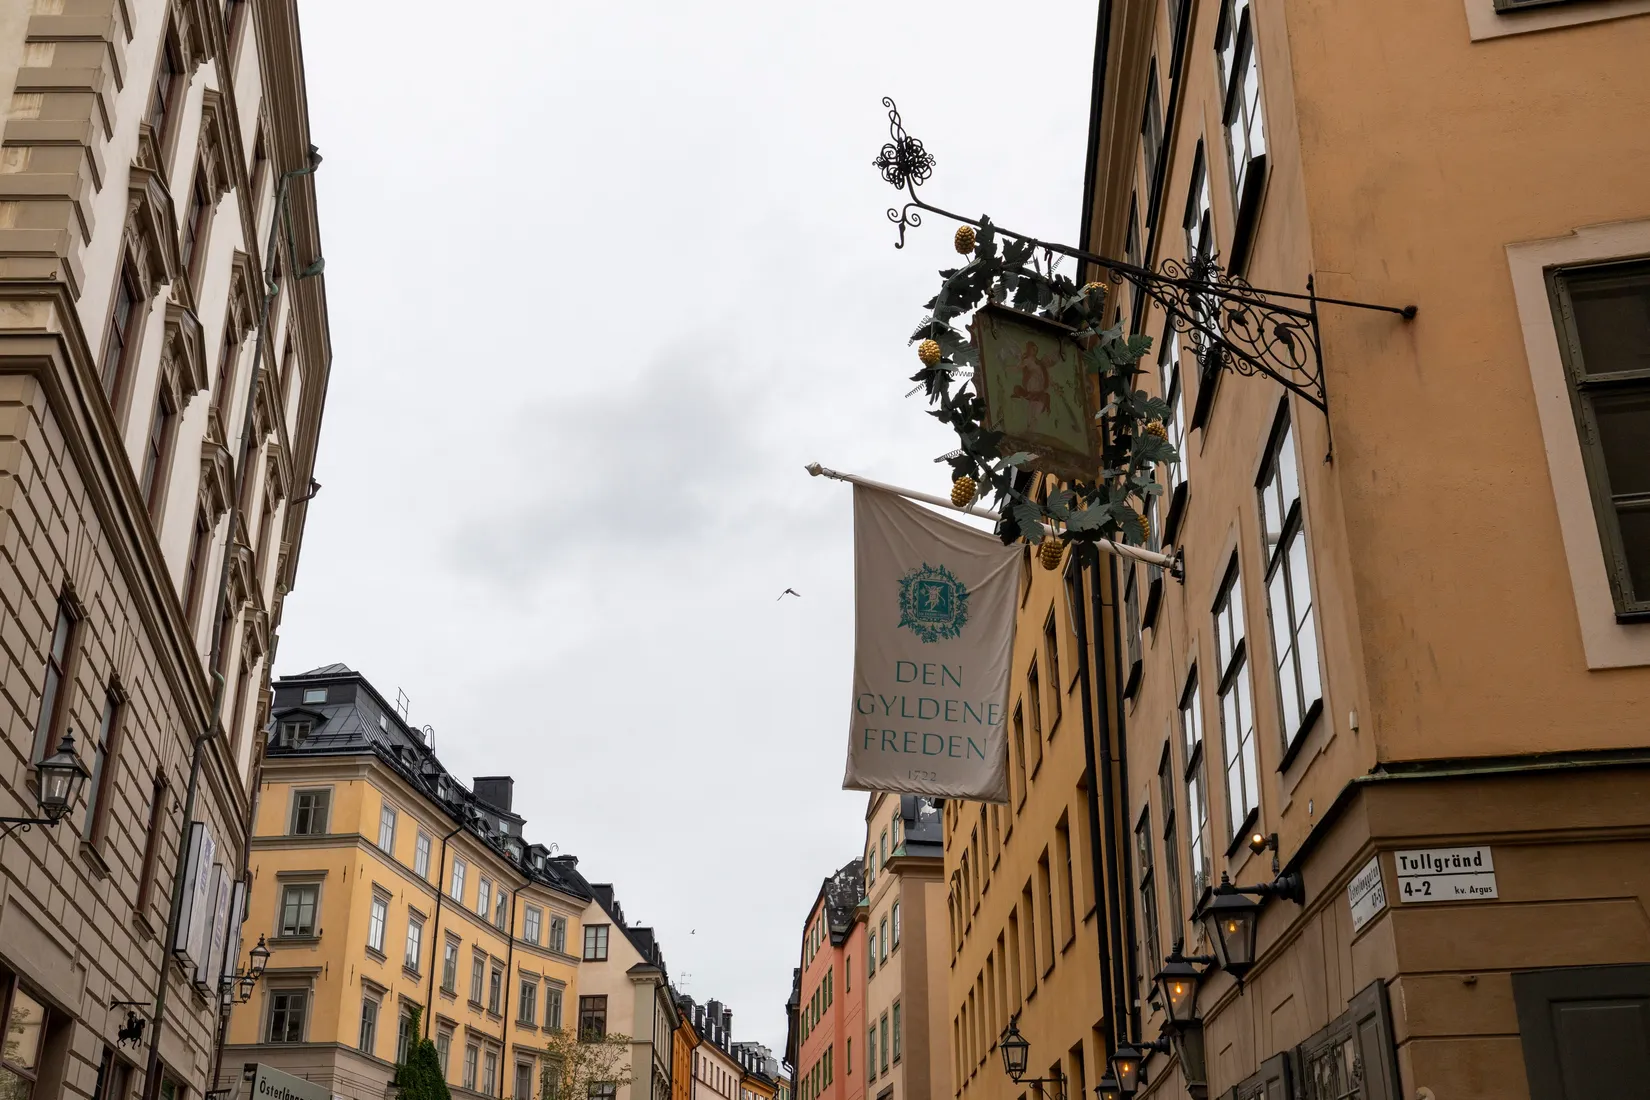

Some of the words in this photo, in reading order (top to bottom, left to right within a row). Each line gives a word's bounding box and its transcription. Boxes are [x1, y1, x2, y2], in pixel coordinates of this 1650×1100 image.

[896, 660, 963, 688] DEN
[857, 694, 1000, 726] GYLDENE
[864, 729, 987, 761] FREDEN
[908, 770, 937, 782] 1722
[1400, 851, 1482, 872] Tullgränd
[1404, 881, 1432, 896] 4-2
[1454, 886, 1467, 894] kv.
[1469, 885, 1493, 895] Argus
